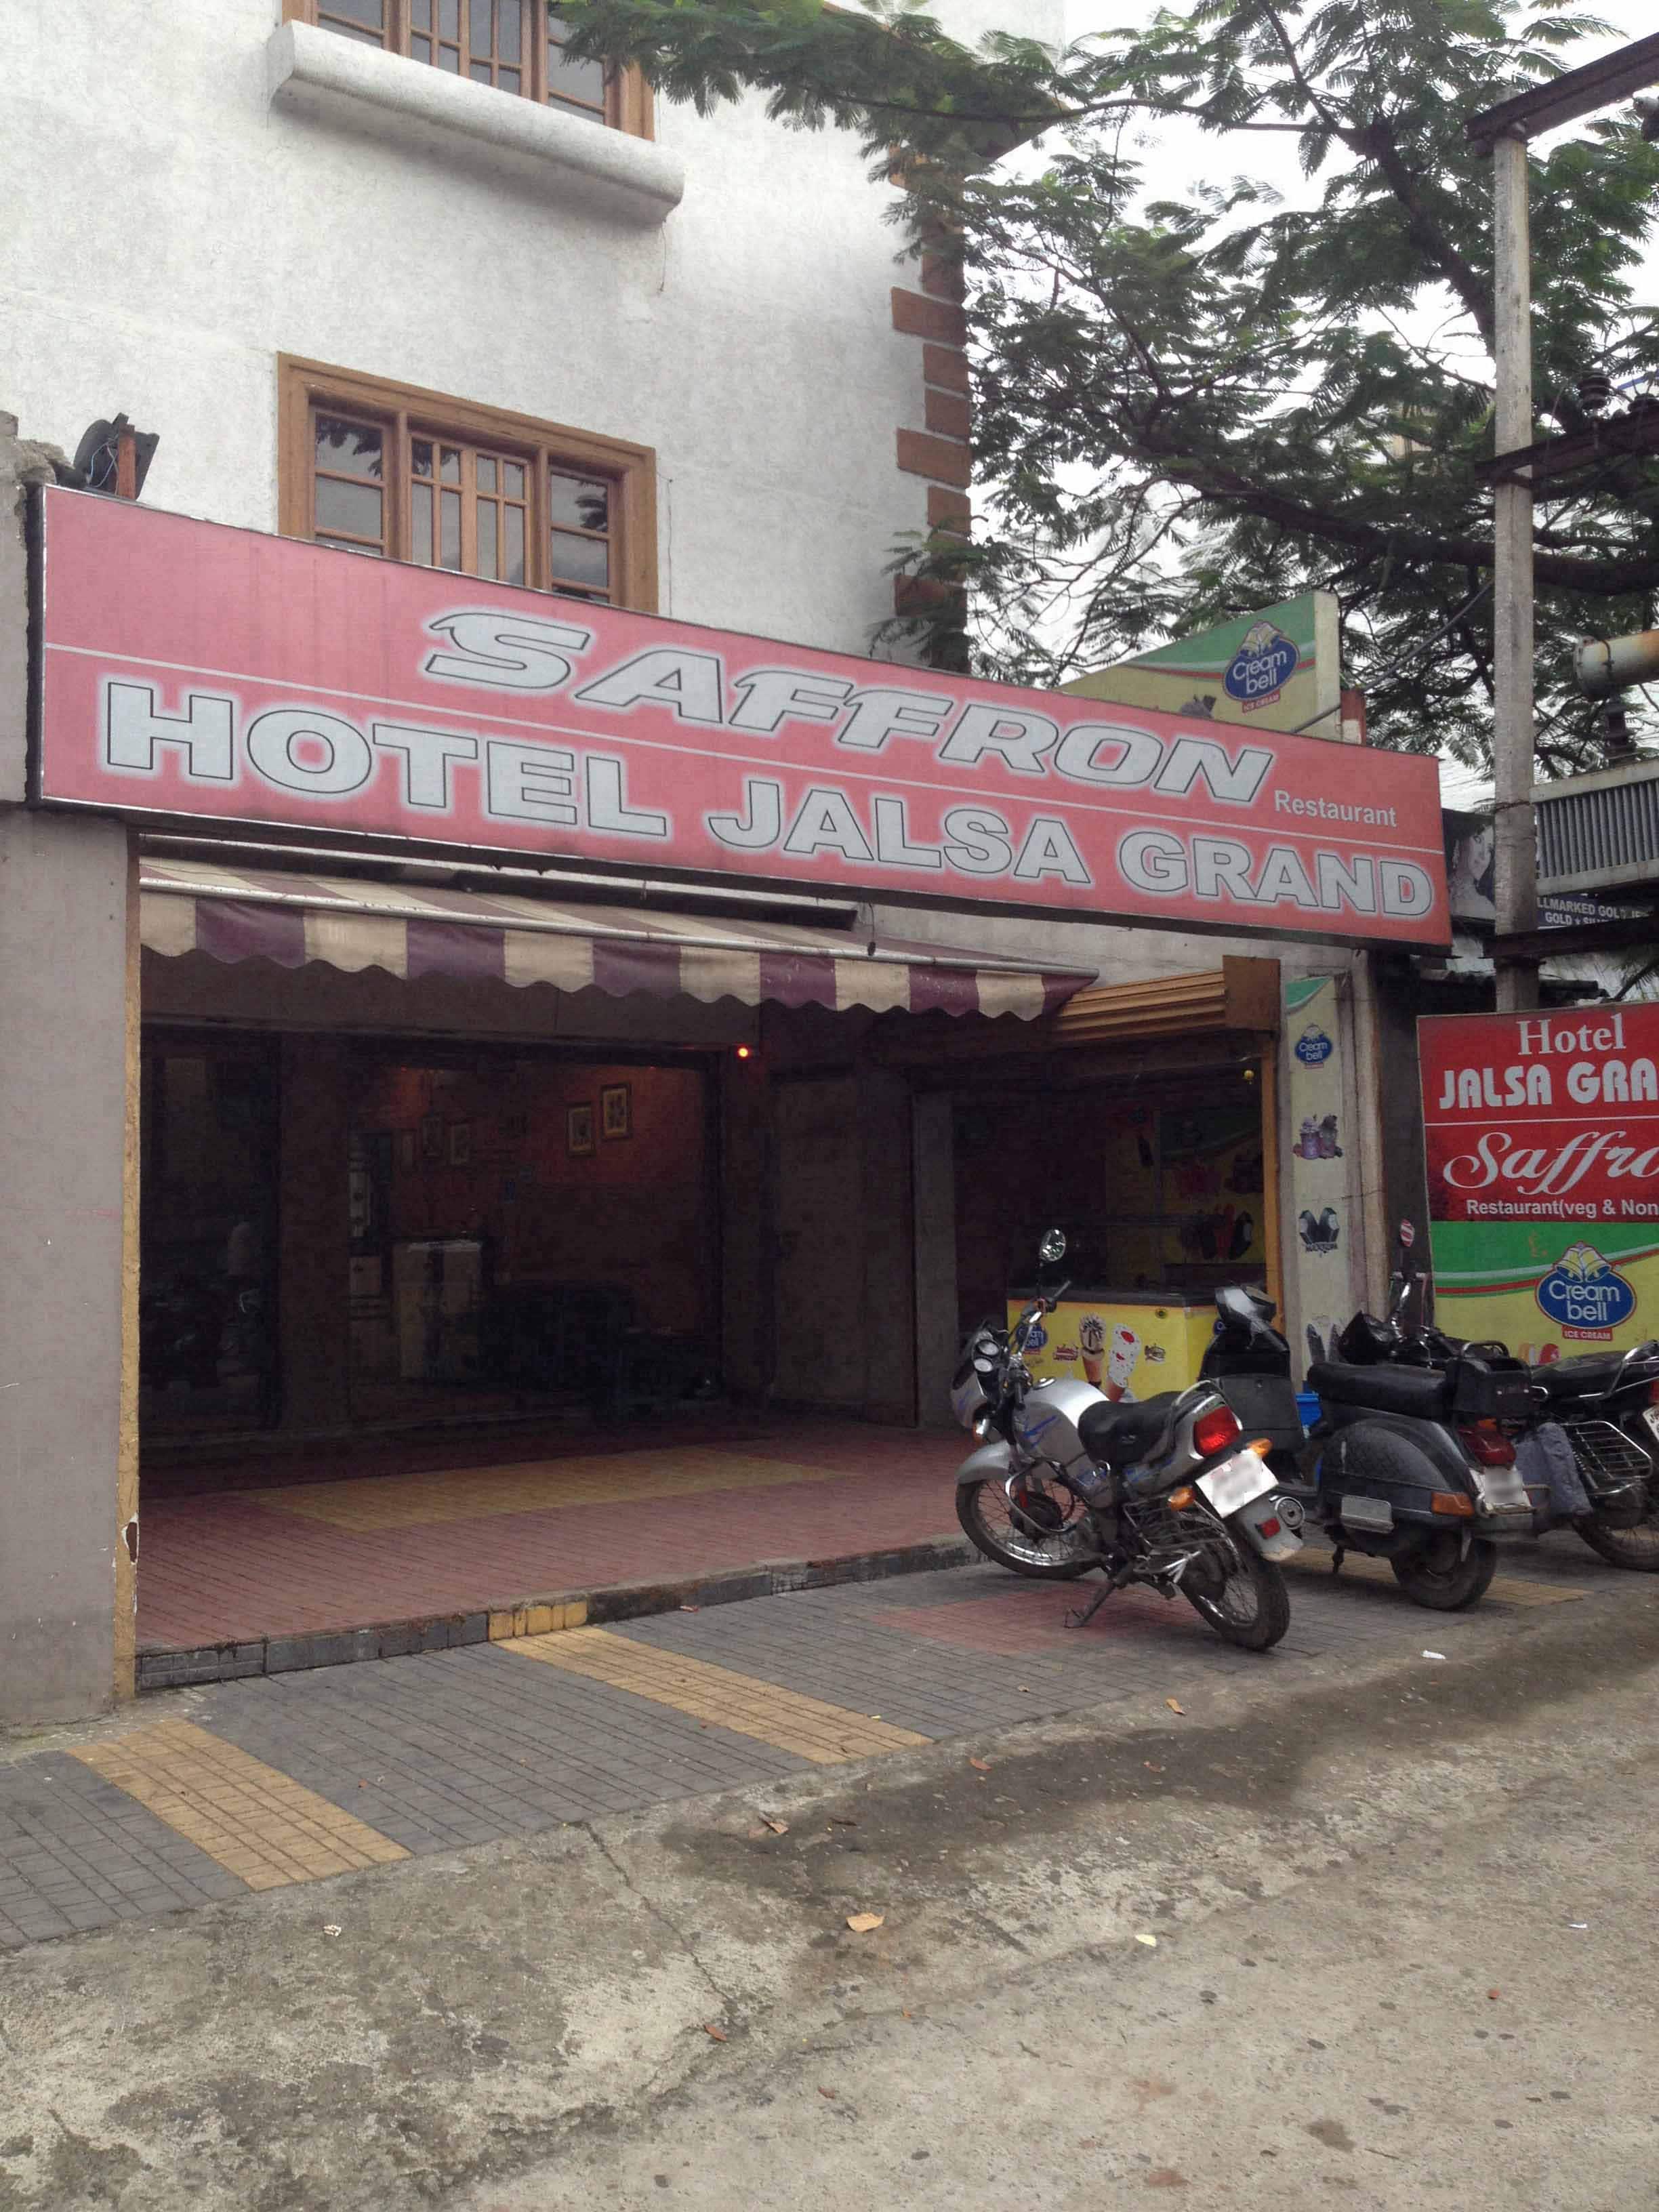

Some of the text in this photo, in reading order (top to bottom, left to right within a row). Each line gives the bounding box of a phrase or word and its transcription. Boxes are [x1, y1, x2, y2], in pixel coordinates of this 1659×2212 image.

[1233, 651, 1287, 680] Cream
[1246, 668, 1277, 694] bell
[422, 609, 1275, 804] SAFFRON
[105, 678, 1434, 918] HOTEL JALSA GRAND
[1273, 790, 1397, 827] Restaurant
[1544, 912, 1572, 926] GOLD
[1516, 1013, 1626, 1055] Hotel
[1439, 1058, 1658, 1109] JALSA GRA
[1602, 1199, 1616, 1214] &
[1549, 1280, 1620, 1301] Cream
[1567, 1300, 1607, 1321] bell
